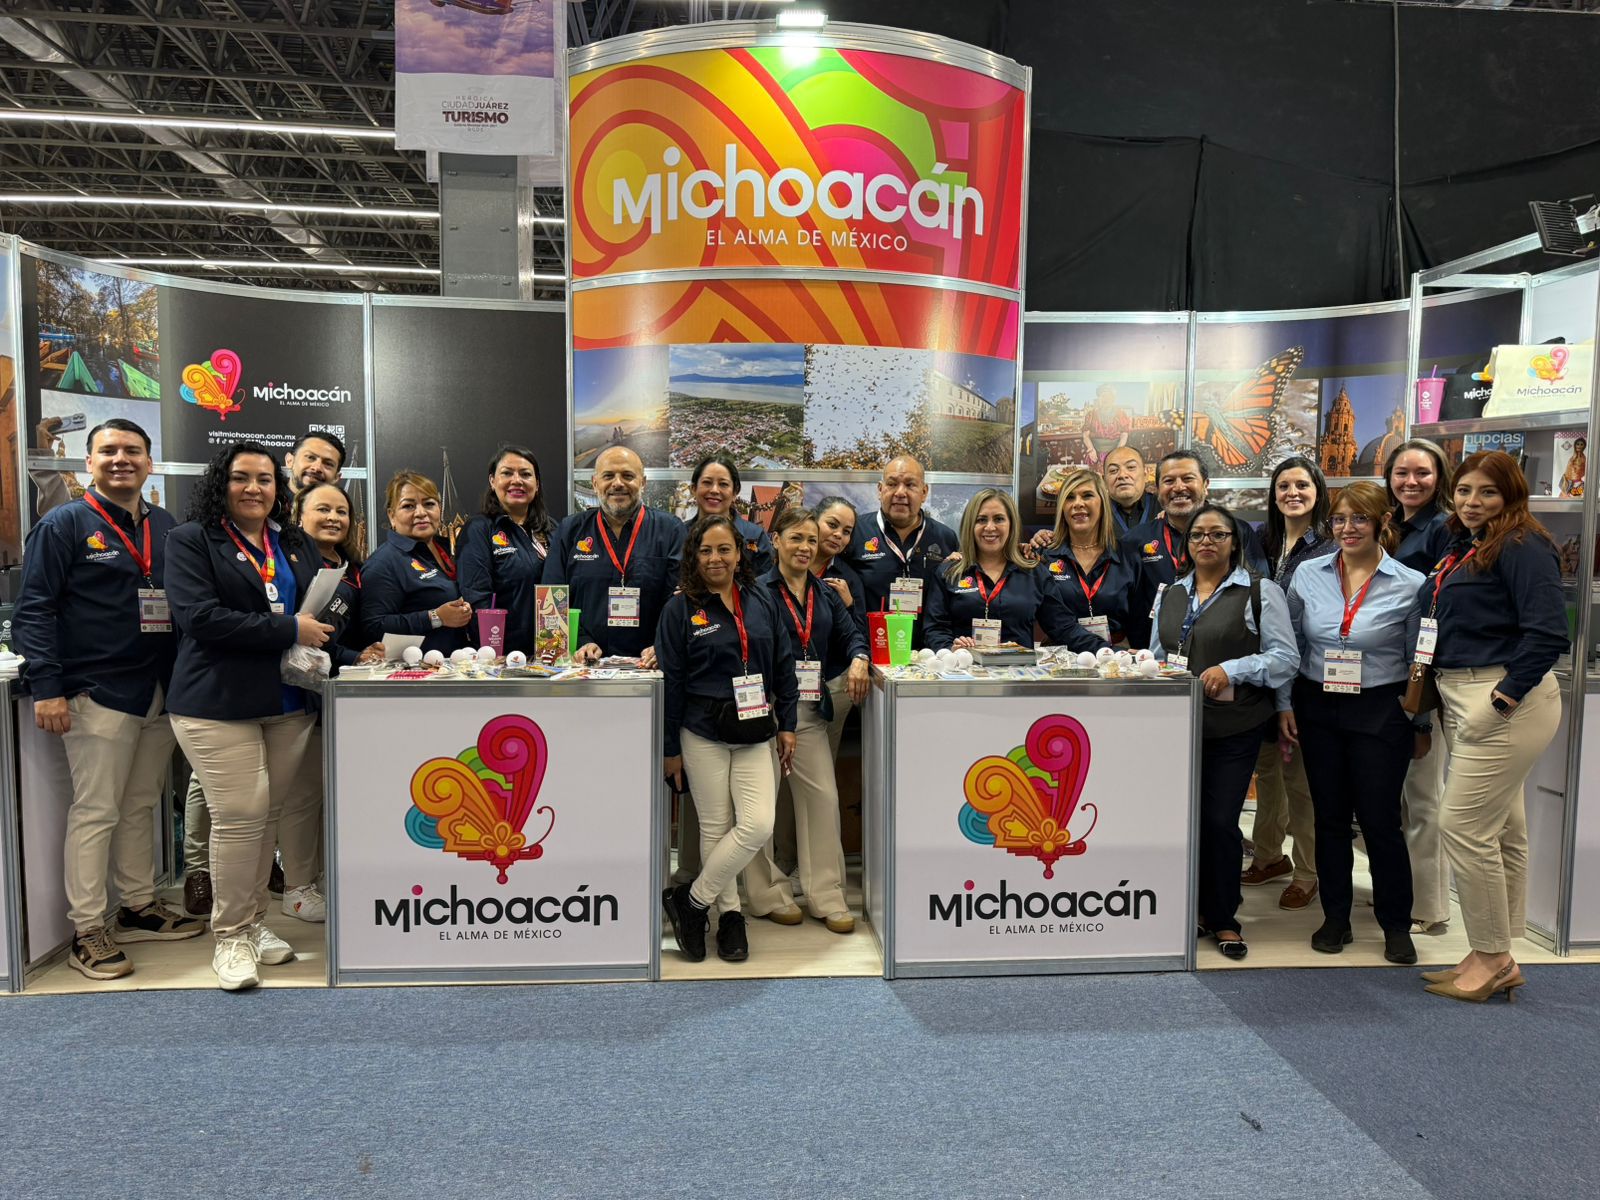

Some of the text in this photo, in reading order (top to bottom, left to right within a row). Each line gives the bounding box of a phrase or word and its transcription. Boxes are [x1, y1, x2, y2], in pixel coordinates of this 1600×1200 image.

[442, 111, 509, 124] TURISMO
[612, 143, 984, 240] Michoacán
[706, 227, 908, 252] EL ALMA DE MÉXICO
[253, 382, 351, 403] Michoacán
[1516, 384, 1582, 397] Michoacán
[208, 430, 296, 440] visitmichoacan.com.mx
[375, 884, 618, 932] Michoacán
[929, 880, 1157, 927] Michoacán
[439, 927, 562, 941] EL ALMA DE MÉXICO
[989, 921, 1104, 935] EL ALMA DE MÉXICO
